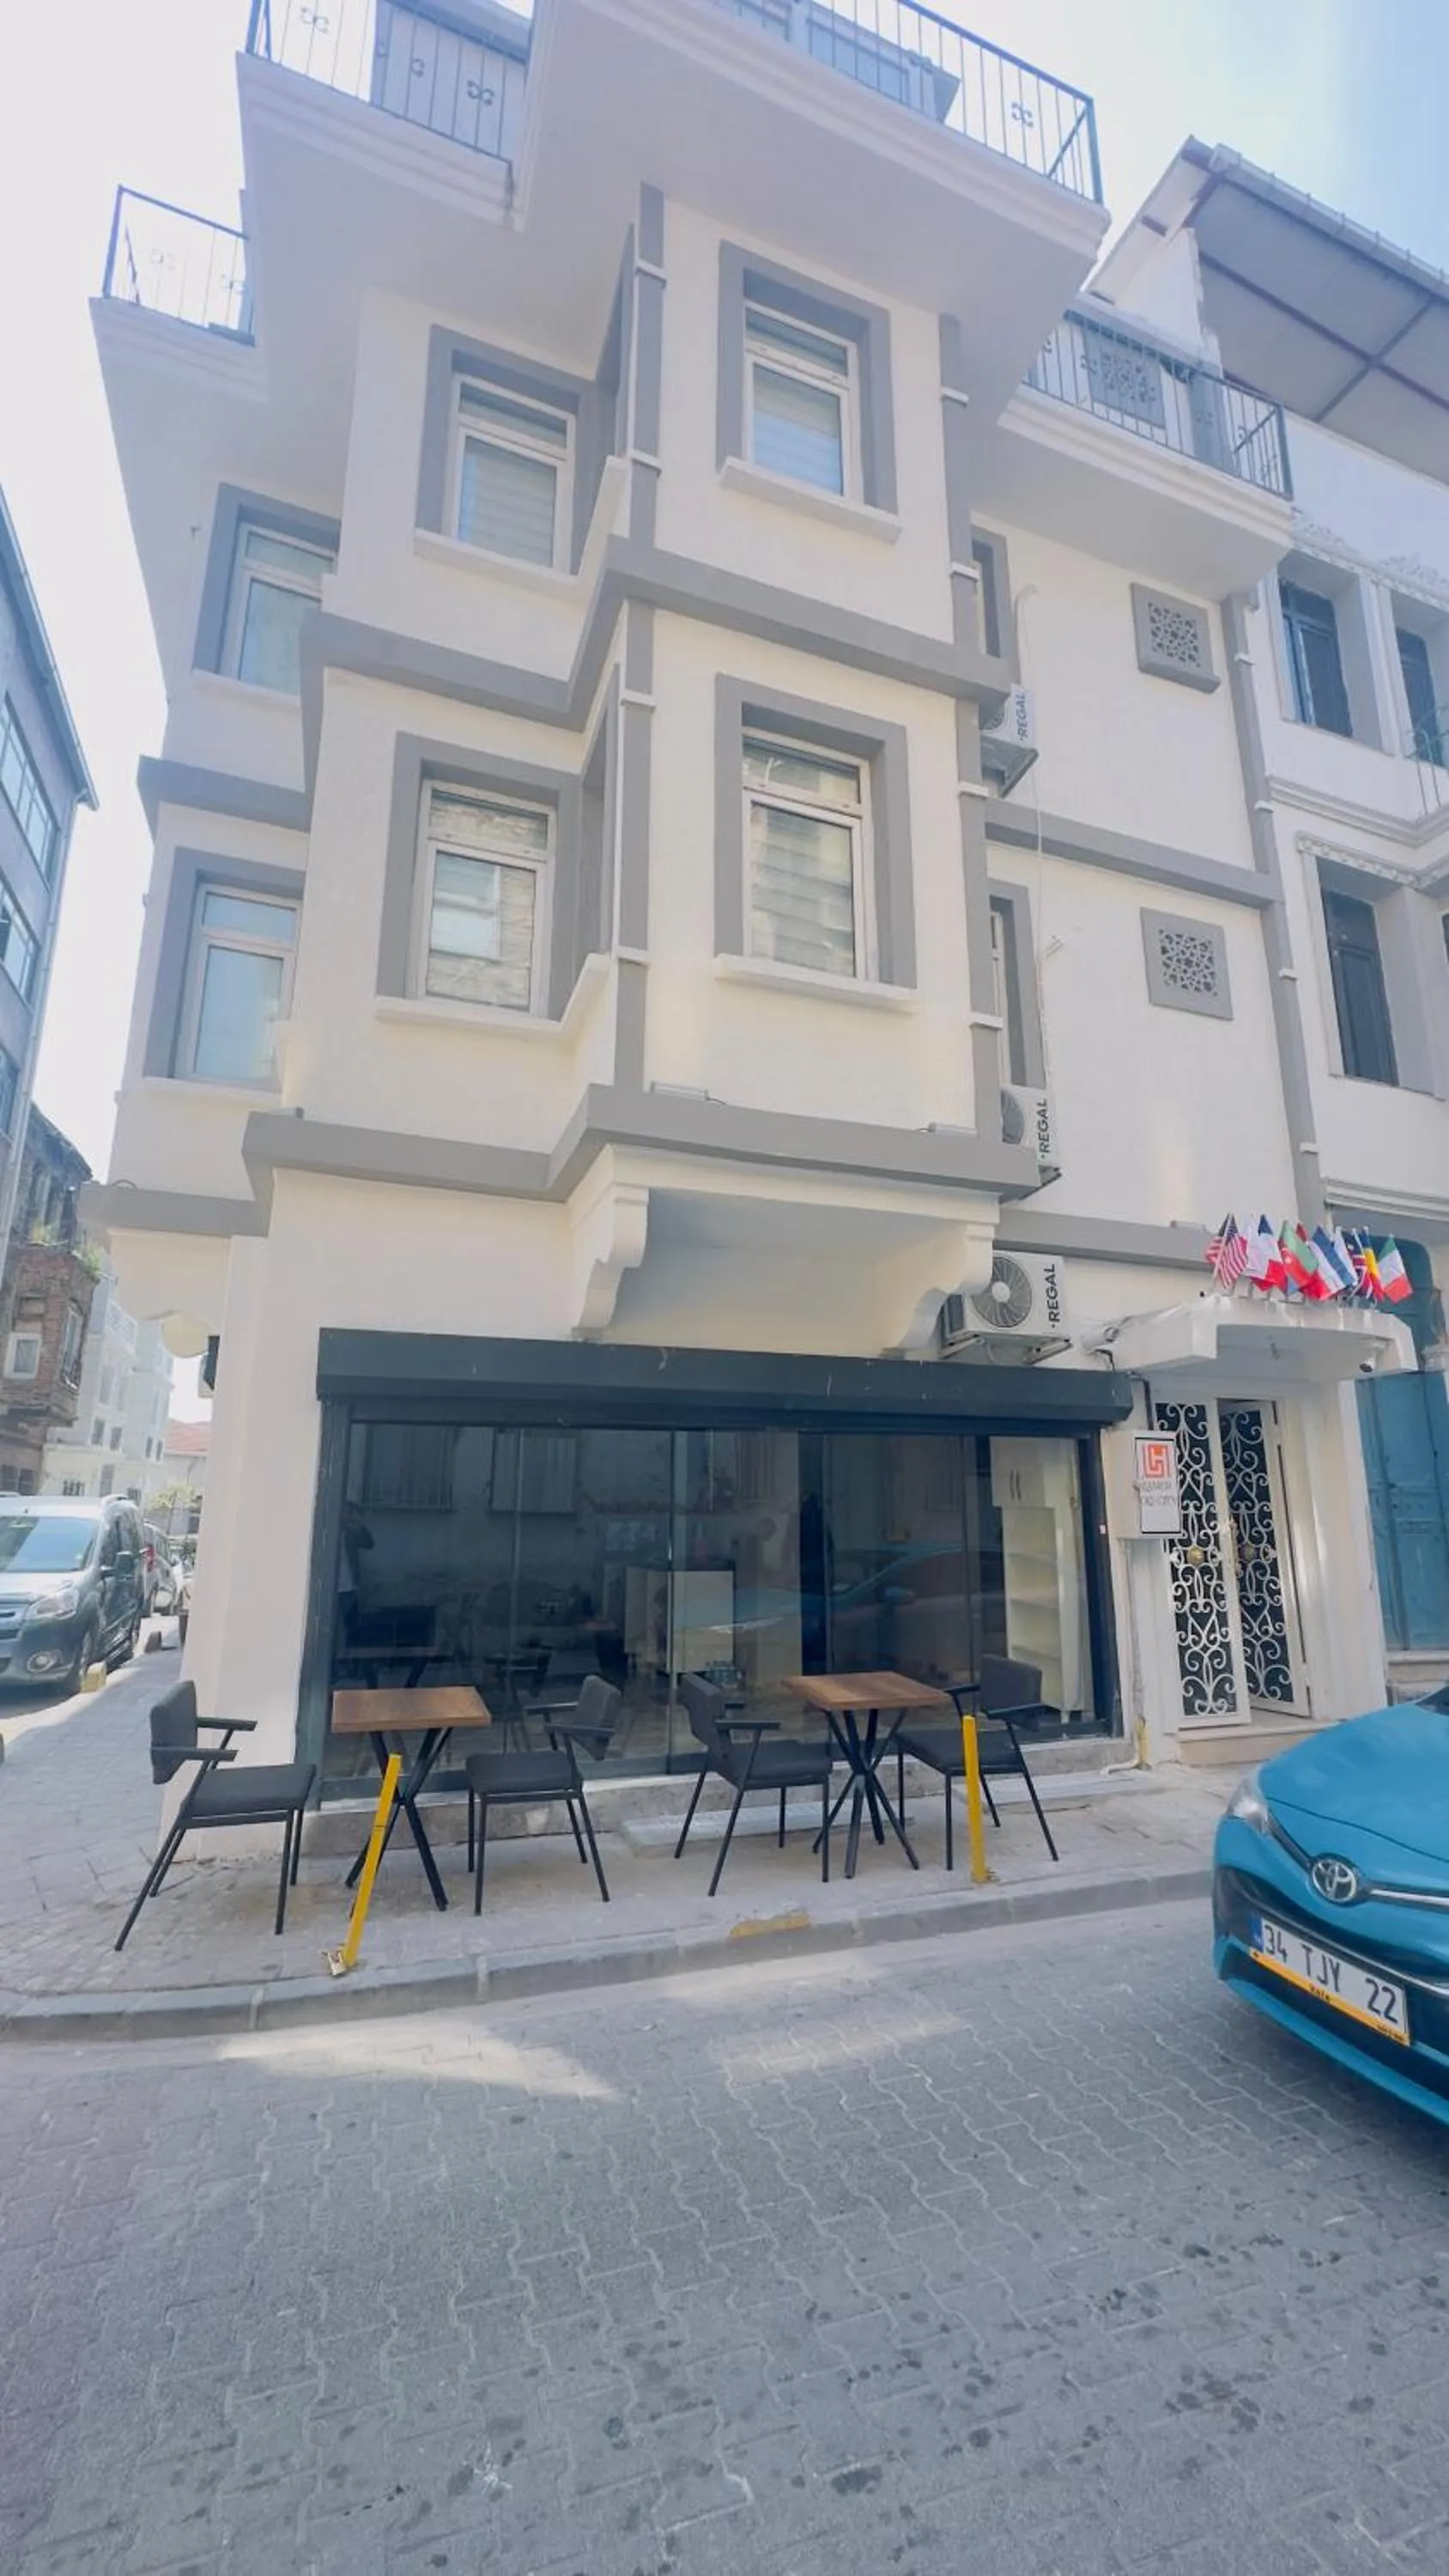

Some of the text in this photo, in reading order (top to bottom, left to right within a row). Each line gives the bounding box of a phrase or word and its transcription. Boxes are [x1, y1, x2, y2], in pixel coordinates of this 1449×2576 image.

[1016, 692, 1028, 738] REGAL
[1036, 1098, 1050, 1154] REGAL
[1044, 1263, 1060, 1323] REGAL
[1264, 1923, 1288, 1964] 34
[1300, 1943, 1341, 1993] TJY
[1365, 1977, 1398, 2025] 22
